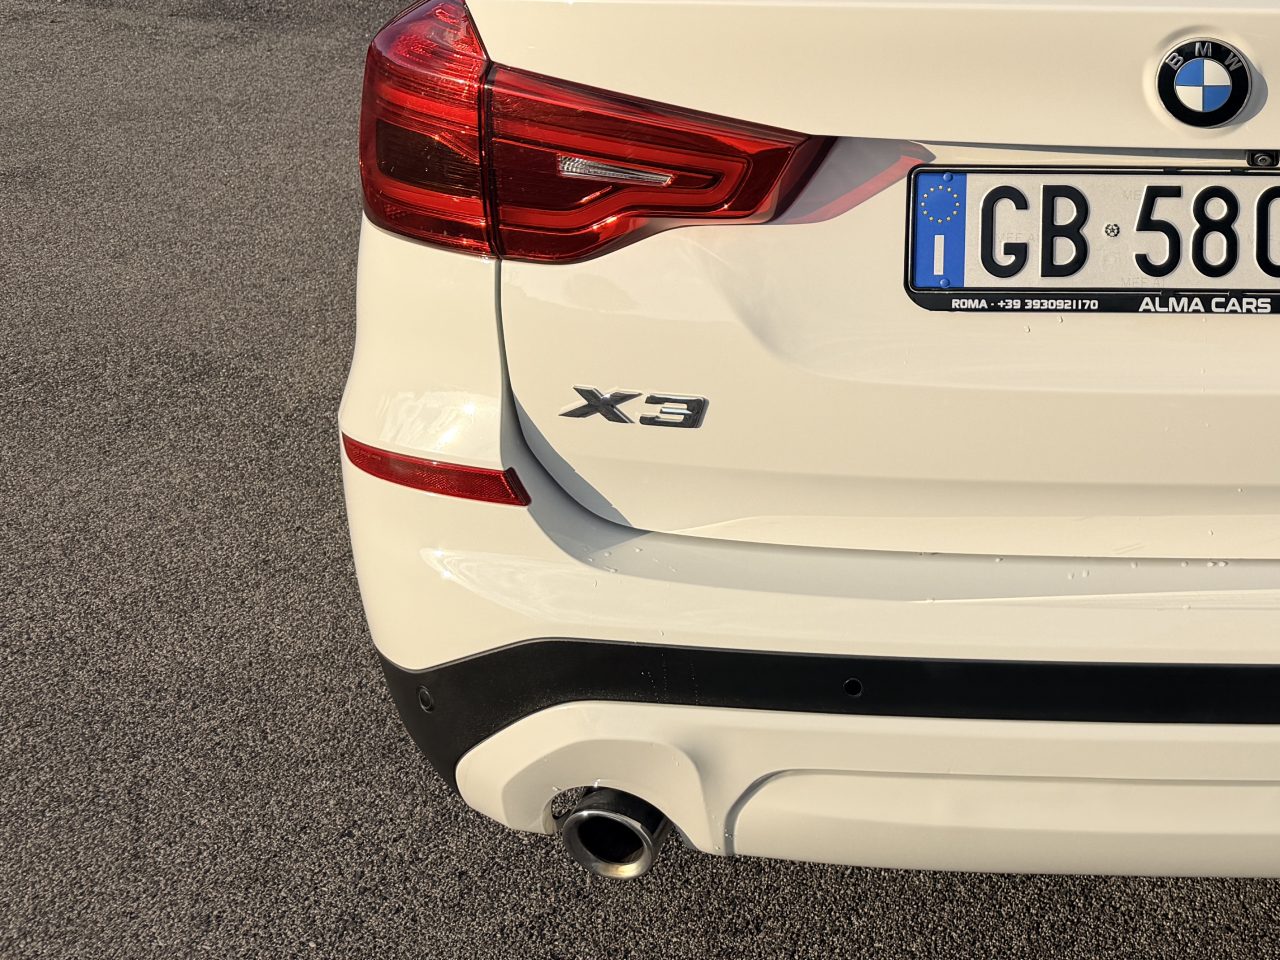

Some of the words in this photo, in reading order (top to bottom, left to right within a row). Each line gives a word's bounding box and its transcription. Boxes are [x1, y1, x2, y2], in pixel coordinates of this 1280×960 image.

[1164, 41, 1243, 72] BMW
[980, 184, 1089, 279] GB
[951, 298, 989, 309] ROMA
[997, 299, 1021, 309] +39
[1024, 299, 1099, 310] 3930921170
[1138, 296, 1205, 313] ALMA
[1210, 297, 1272, 314] CARS
[558, 385, 710, 429] X3
